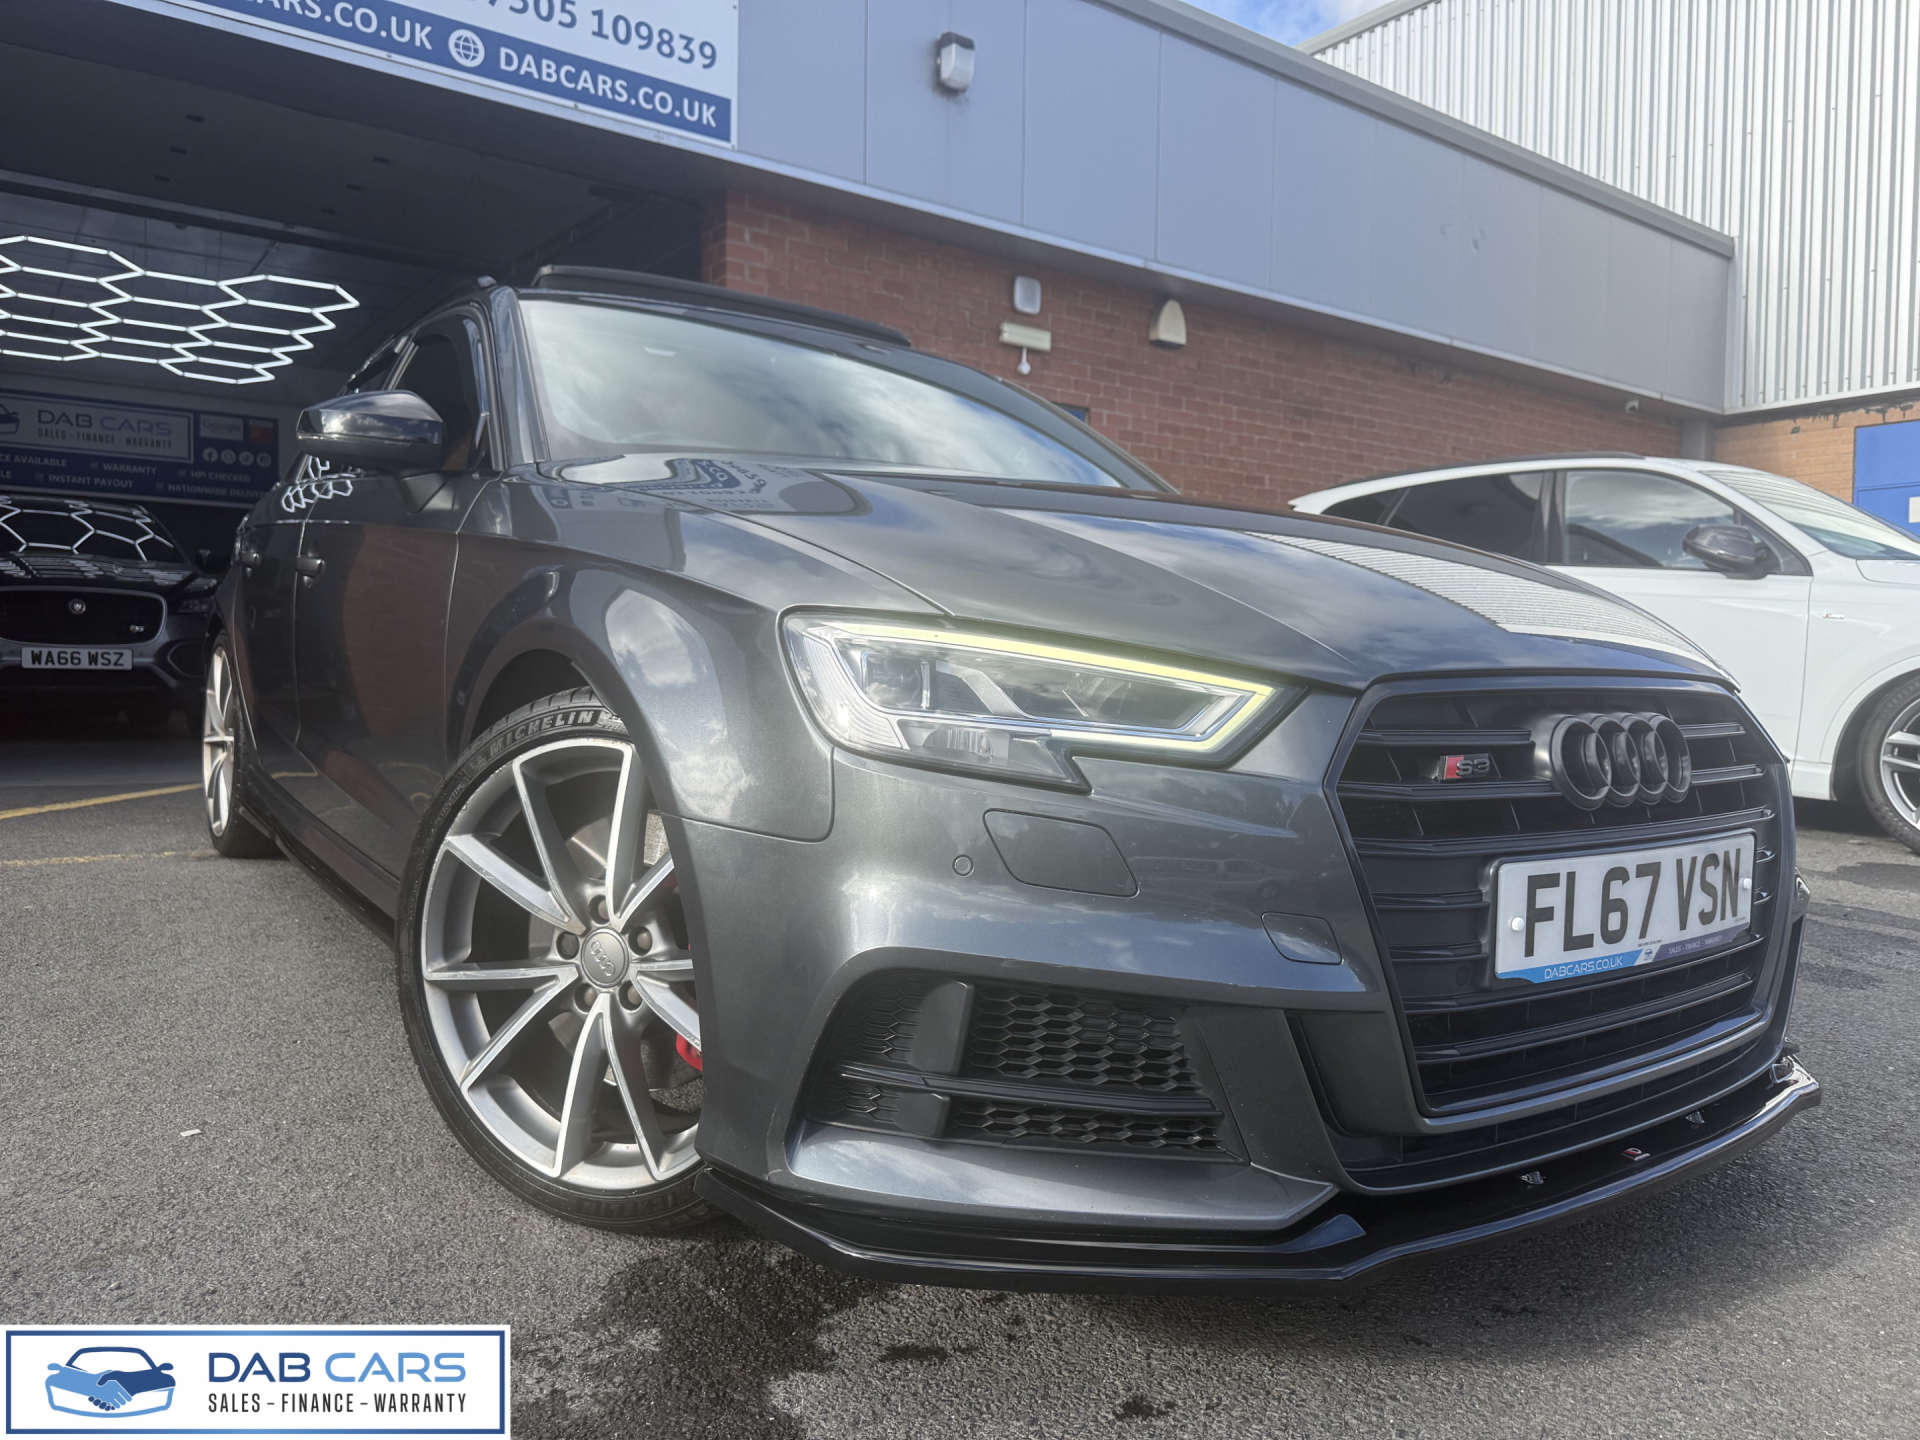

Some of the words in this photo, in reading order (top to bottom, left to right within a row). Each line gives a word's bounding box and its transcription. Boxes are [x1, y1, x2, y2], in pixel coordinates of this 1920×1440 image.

[591, 9, 717, 69] 109839
[500, 47, 717, 128] DABCARS.CO.UK
[37, 409, 93, 429] DAB
[100, 416, 172, 437] CARS
[30, 651, 82, 666] WA66
[87, 652, 125, 667] WSZ
[489, 710, 594, 757] MICHELIN
[1455, 757, 1490, 777] S3
[1524, 860, 1662, 958] FL67
[1675, 847, 1742, 932] VSN
[1543, 954, 1624, 980] DABCARS.CO.UK
